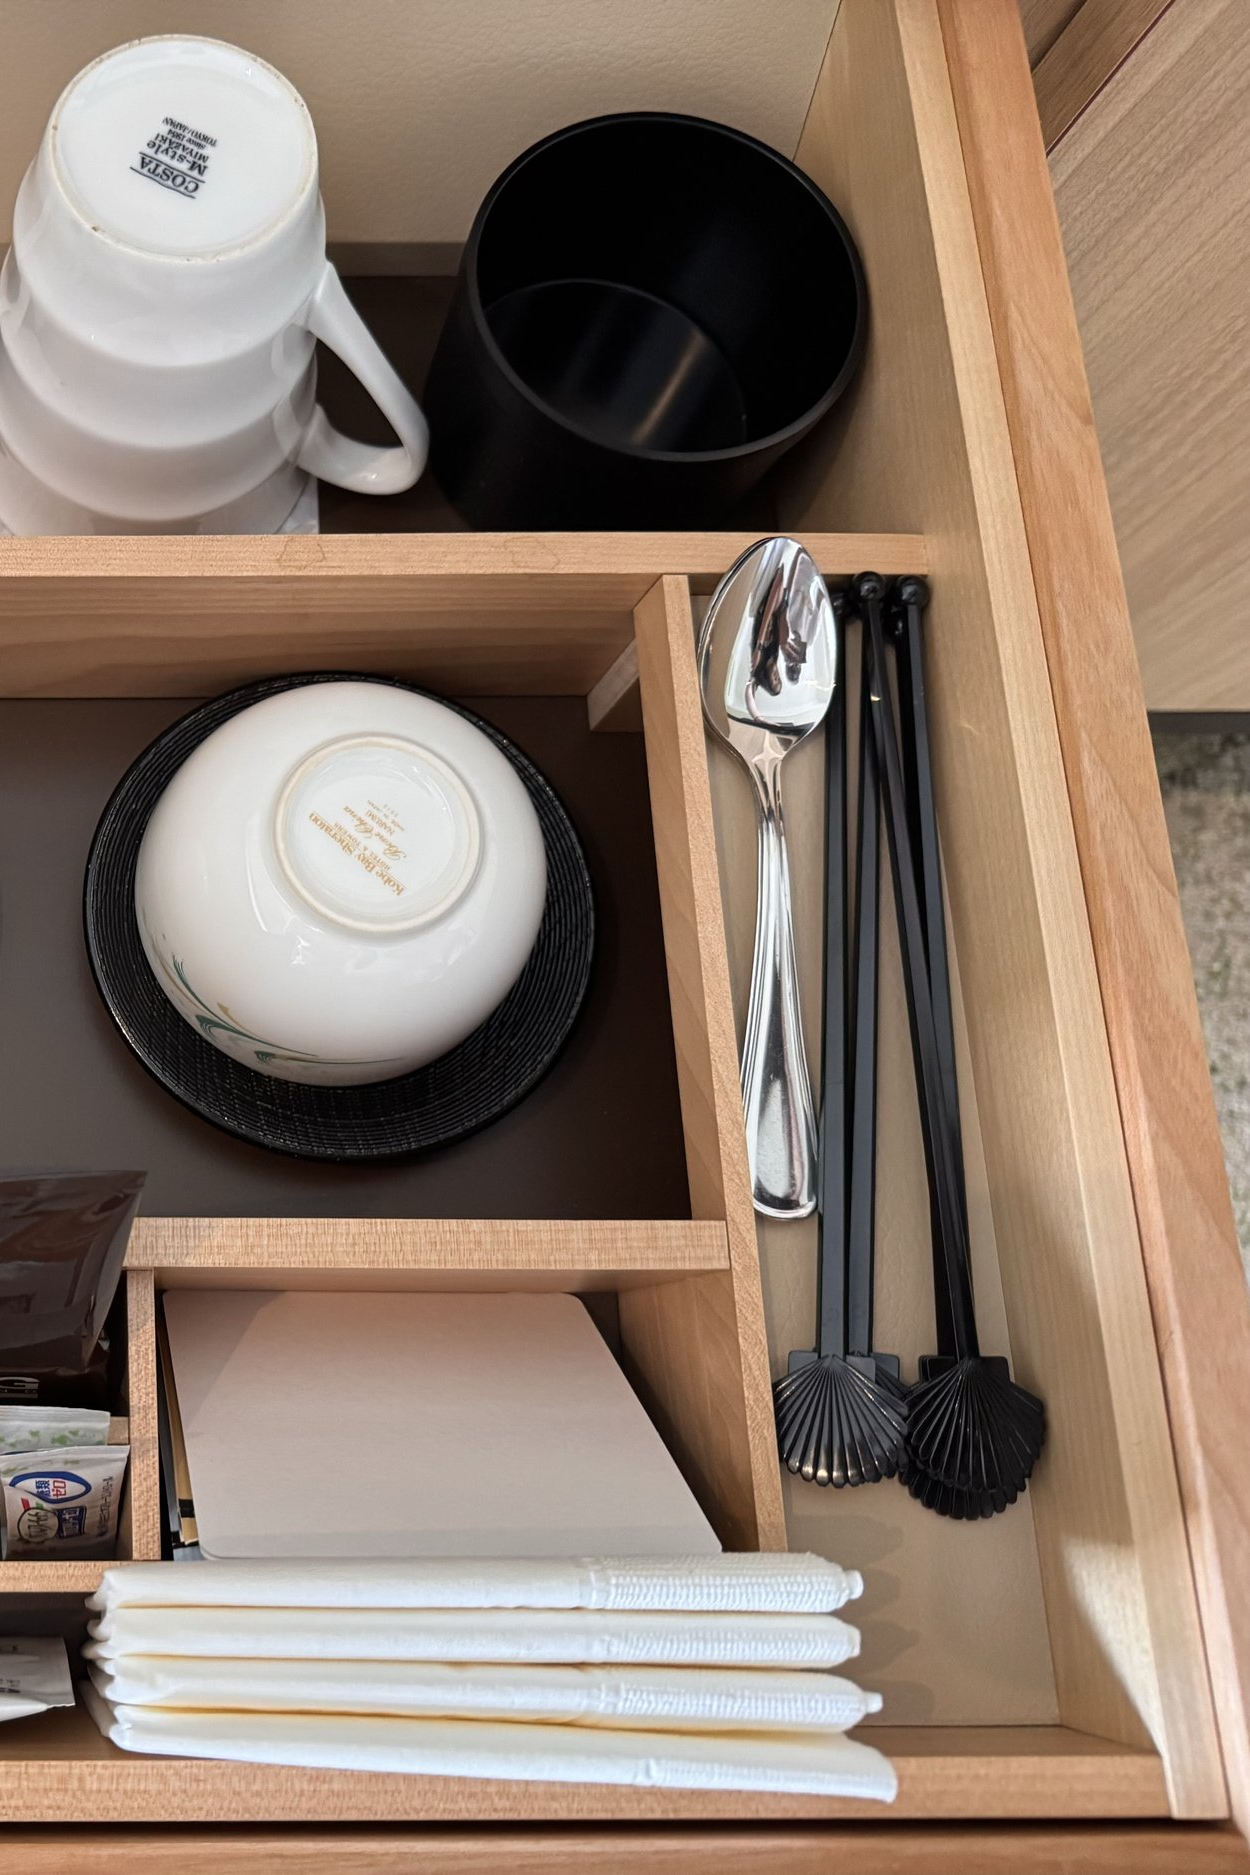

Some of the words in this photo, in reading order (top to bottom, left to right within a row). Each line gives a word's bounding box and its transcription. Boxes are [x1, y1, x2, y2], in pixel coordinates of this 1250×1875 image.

[146, 140, 208, 176] M-style
[154, 133, 209, 163] MIYAZAKI
[139, 155, 200, 194] COSTA
[308, 812, 356, 855] Sheraton
[354, 853, 376, 873] Bay
[376, 870, 404, 896] Kobe
